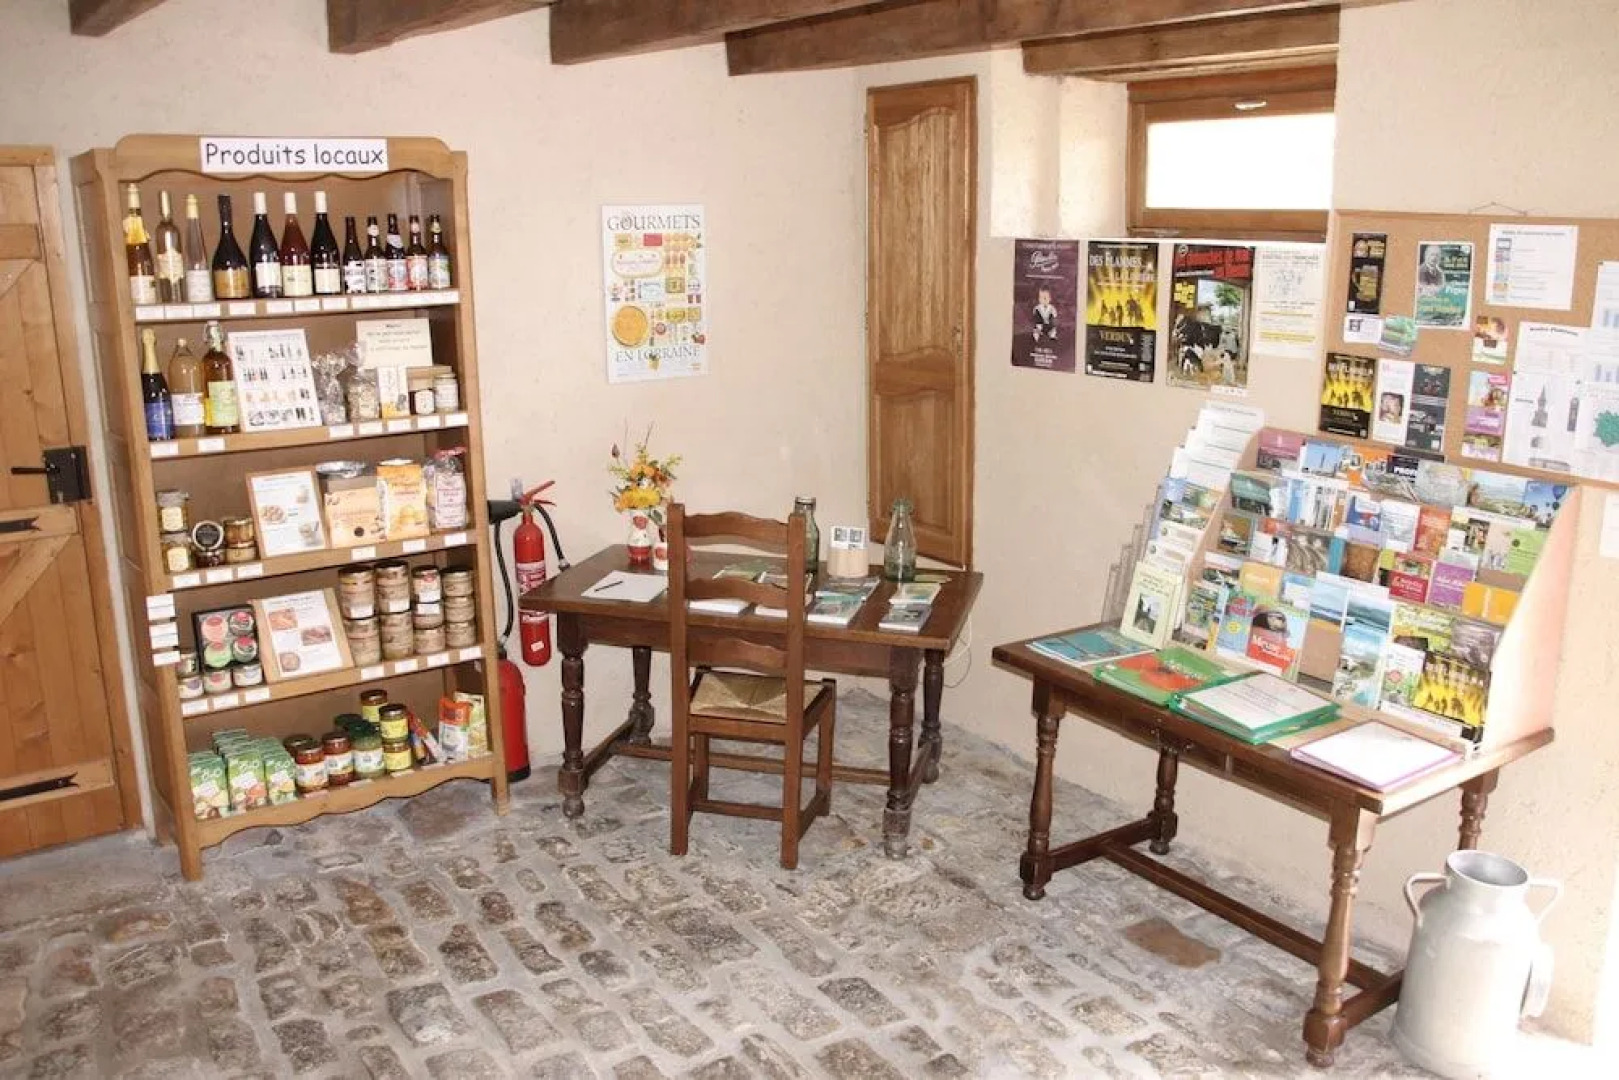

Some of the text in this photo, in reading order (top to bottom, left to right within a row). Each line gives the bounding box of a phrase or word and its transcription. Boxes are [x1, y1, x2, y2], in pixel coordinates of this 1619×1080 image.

[206, 143, 383, 165] Produits locaux
[607, 215, 701, 231] GOURMETS
